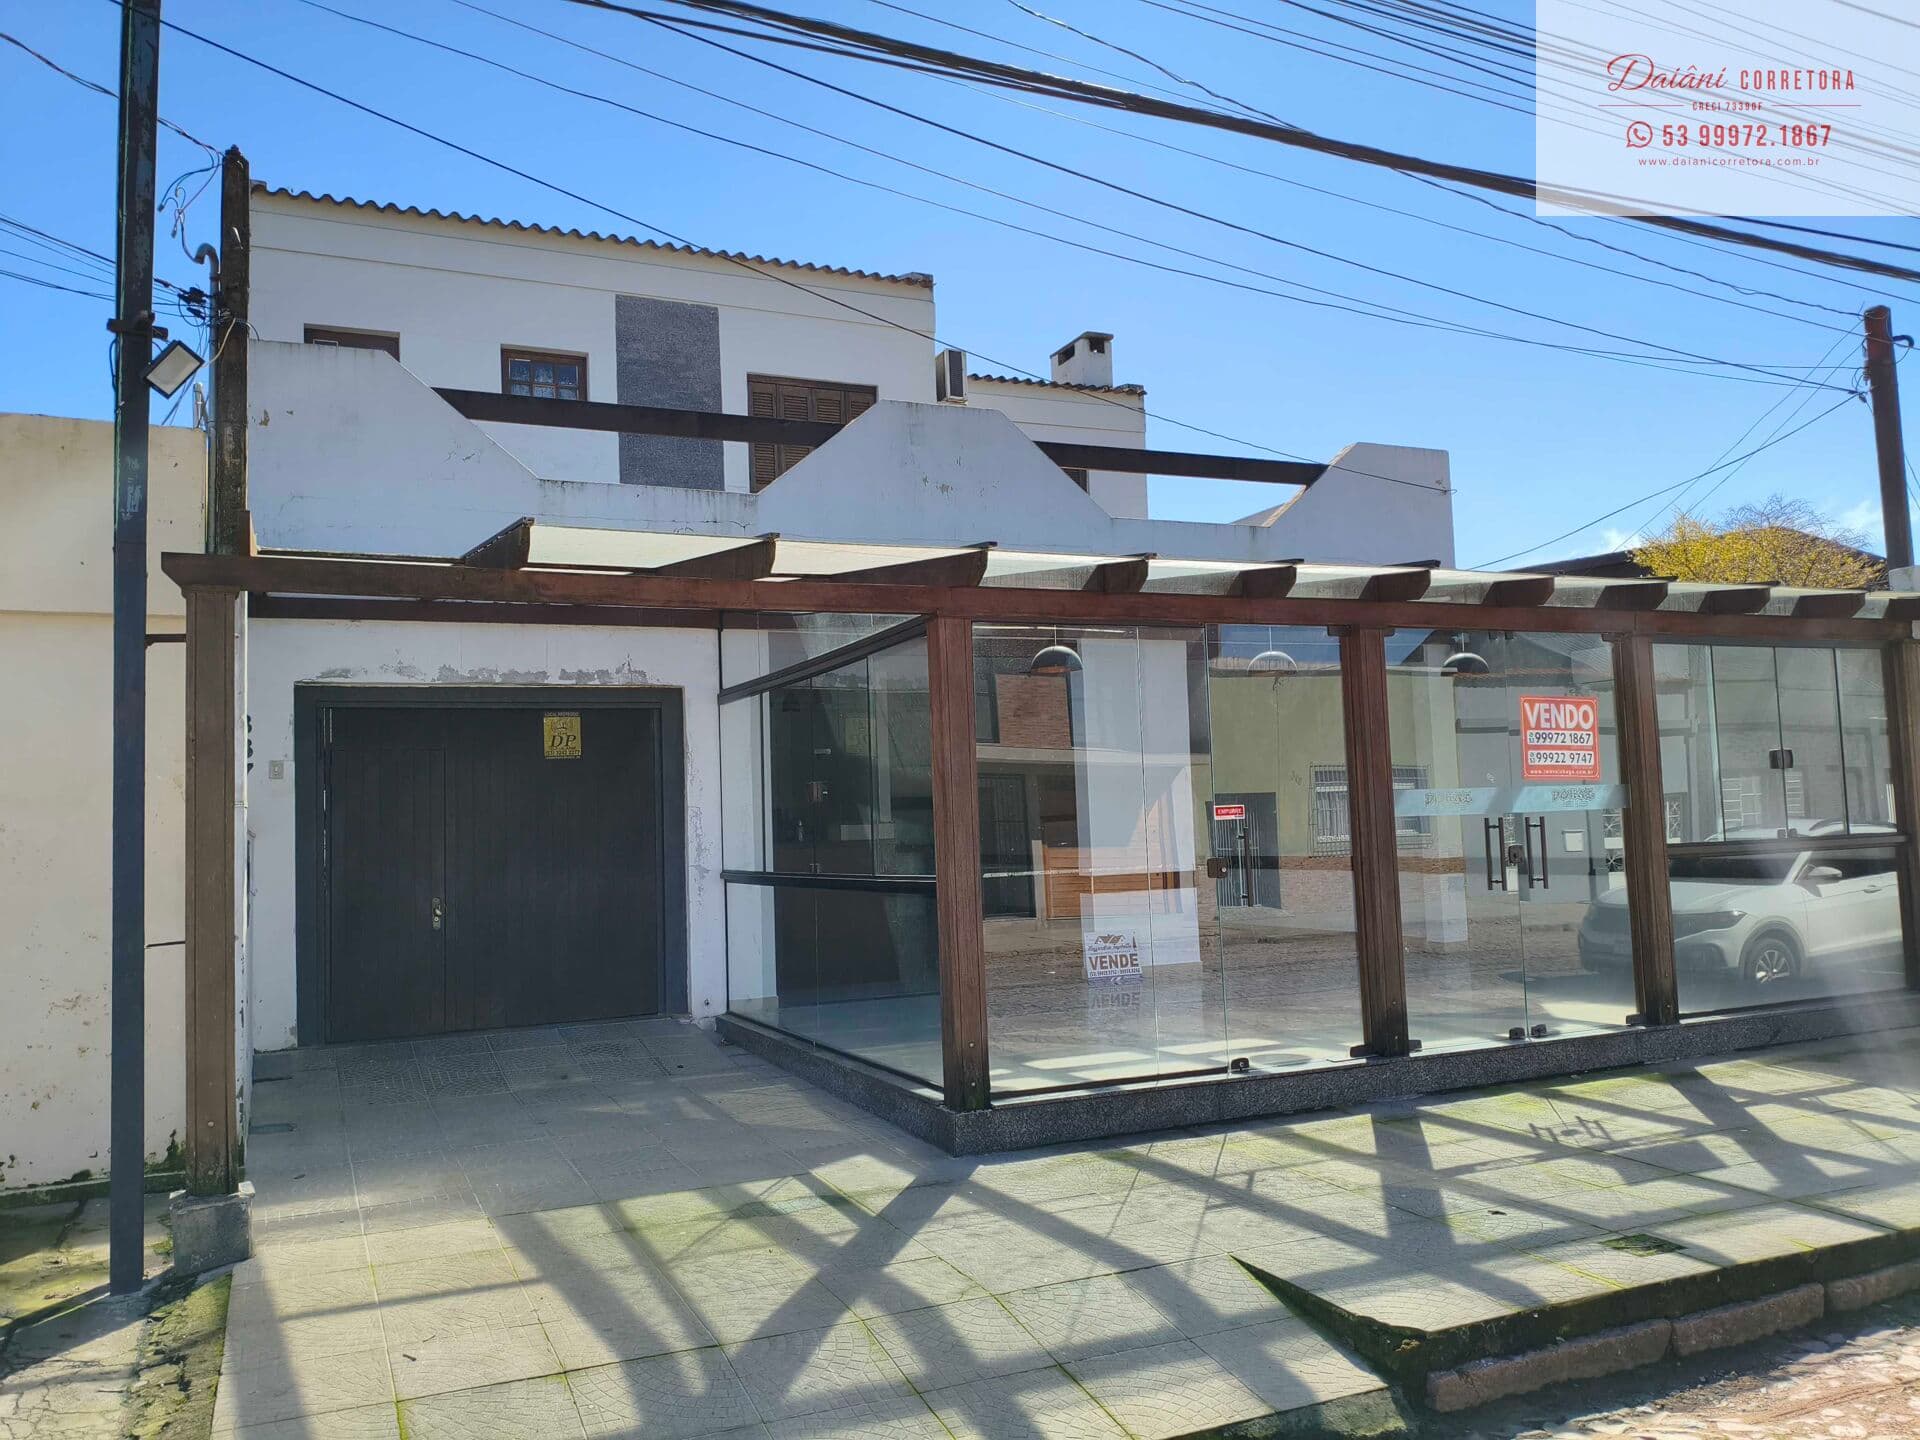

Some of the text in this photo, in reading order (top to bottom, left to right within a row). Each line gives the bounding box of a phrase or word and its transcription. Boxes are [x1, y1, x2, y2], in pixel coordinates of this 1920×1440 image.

[1523, 702, 1594, 730] VENDO
[551, 734, 577, 747] DP
[1535, 731, 1566, 744] 99972
[1569, 732, 1591, 745] 1867
[1536, 752, 1567, 764] 99922
[1569, 752, 1593, 764] 9747
[1088, 953, 1139, 971] VENDE
